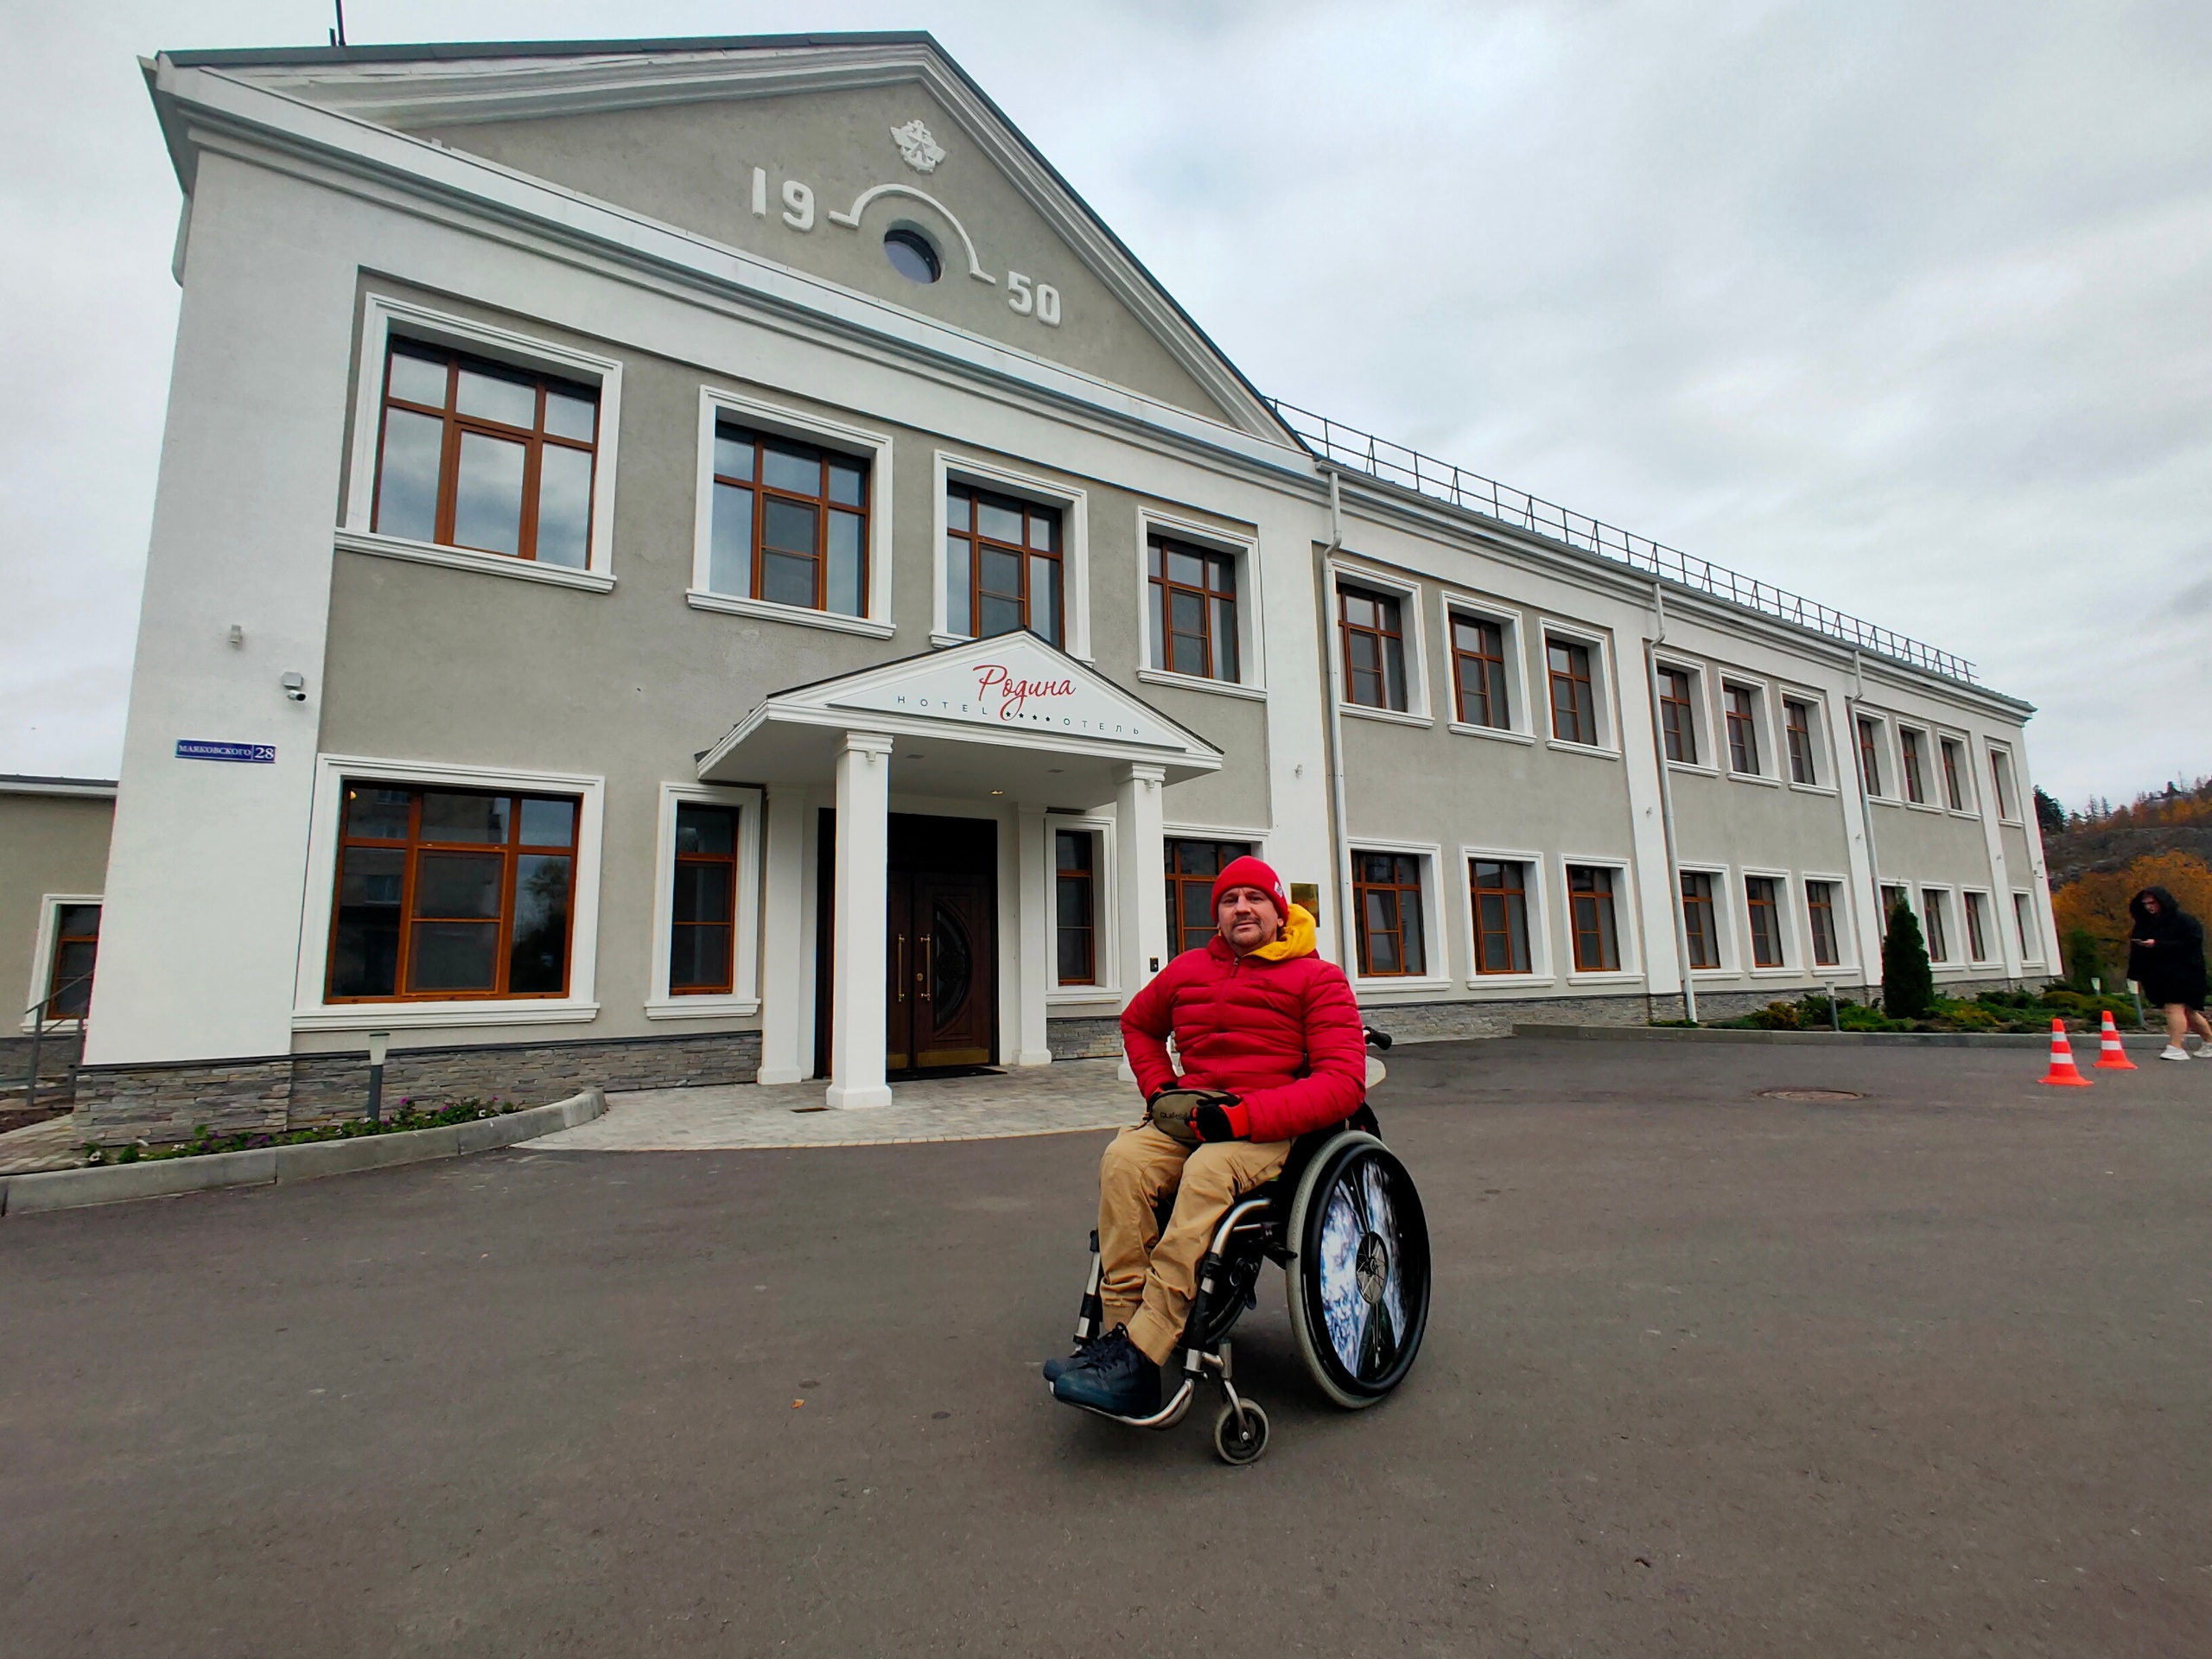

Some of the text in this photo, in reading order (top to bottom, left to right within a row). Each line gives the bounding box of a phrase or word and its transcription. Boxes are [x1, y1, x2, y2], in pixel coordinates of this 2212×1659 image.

[752, 166, 1061, 327] 19 50
[972, 664, 1077, 721] Родина
[898, 696, 988, 715] HOTEL
[1063, 718, 1139, 735] ОТЕЛЬ
[178, 744, 274, 760] МАЯКОВСКОГО 28
